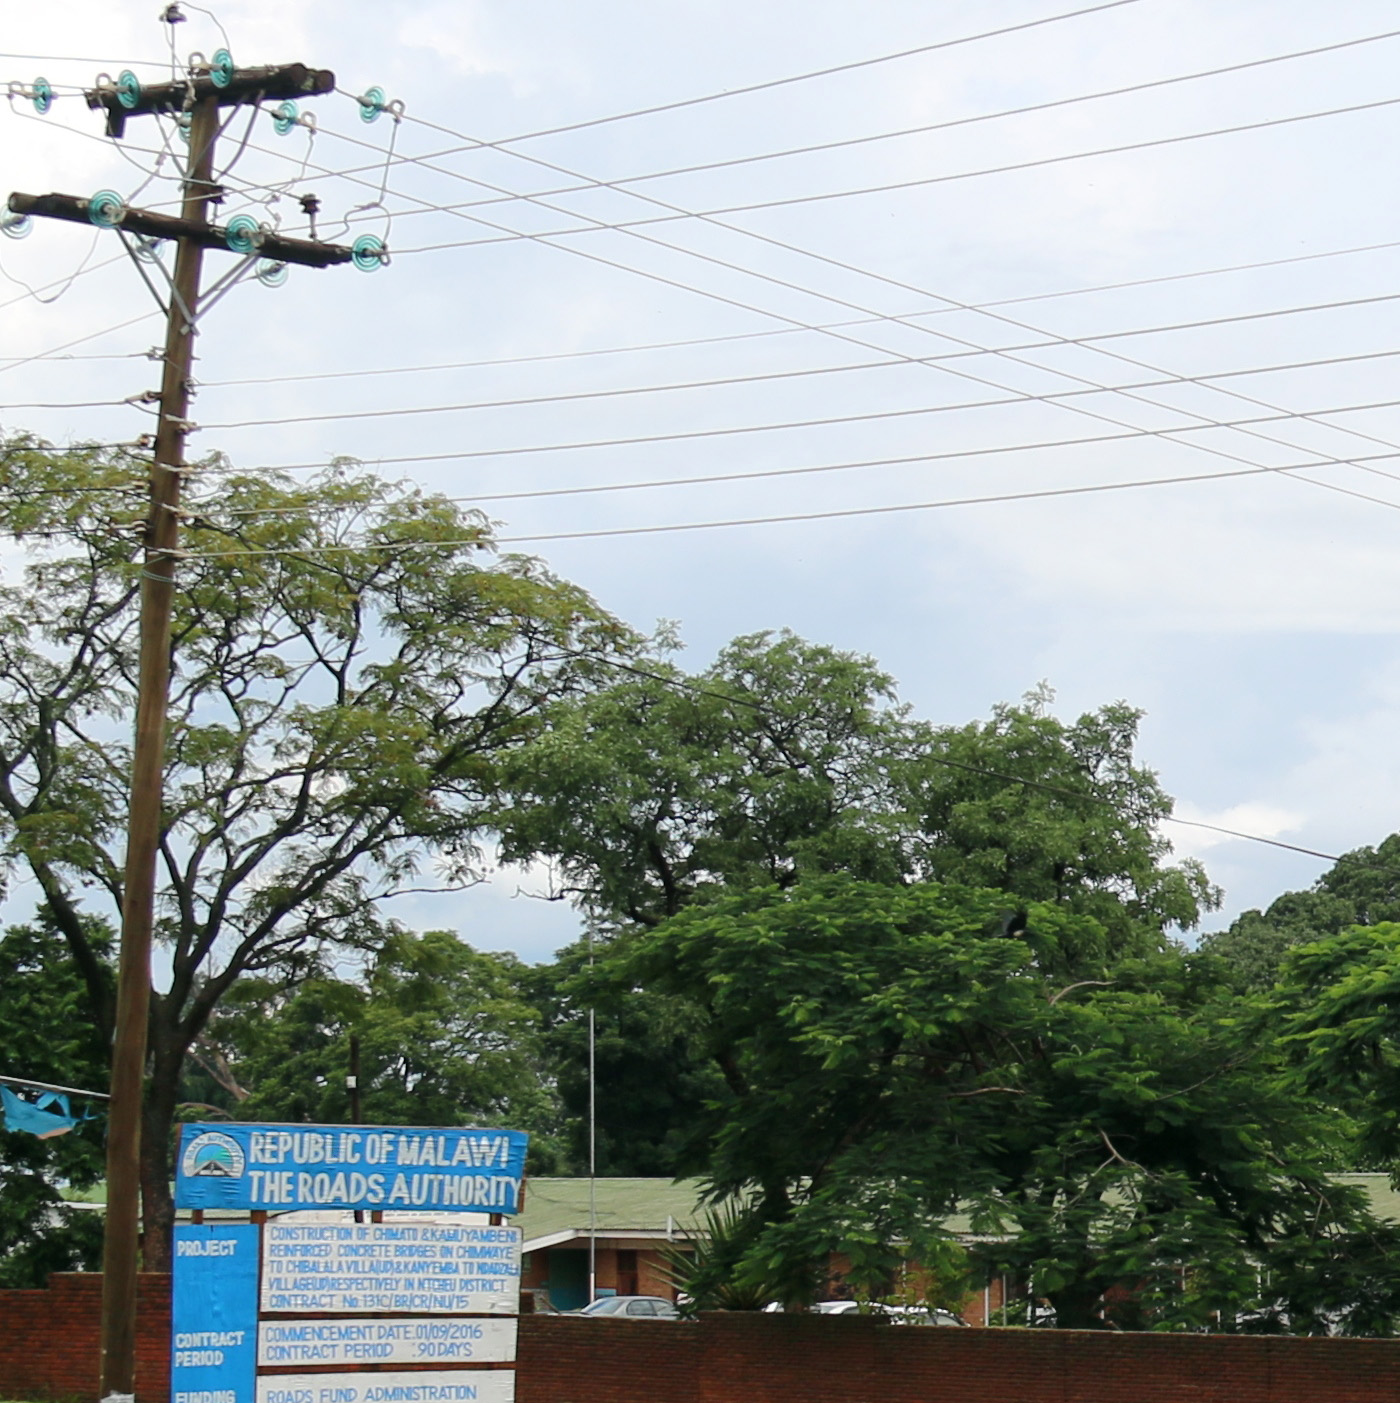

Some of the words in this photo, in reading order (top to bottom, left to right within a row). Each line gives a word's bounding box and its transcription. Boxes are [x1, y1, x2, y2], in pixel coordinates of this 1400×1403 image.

[250, 1131, 360, 1164] REPUBLIC
[366, 1133, 395, 1164] OF
[397, 1135, 509, 1168] MALAWI
[249, 1171, 293, 1203] THE
[298, 1172, 385, 1204] ROADS
[388, 1173, 522, 1208] AUTHORITY
[271, 1226, 352, 1241] CONSTRUCTION
[357, 1227, 370, 1240] OF
[177, 1239, 237, 1257] PROJECT
[269, 1243, 332, 1257] REINFORCED
[338, 1244, 392, 1258] CONCRETE
[394, 1244, 437, 1259] BRIDGES
[269, 1260, 283, 1273] TO
[462, 1262, 475, 1275] TO
[404, 1278, 415, 1291] IN
[269, 1293, 337, 1309] CONTRACT
[175, 1331, 245, 1348] CONTRACT
[265, 1325, 375, 1343] COMMENCEMENT
[175, 1350, 224, 1367] PERIOD
[266, 1344, 338, 1360] CONTRACT
[344, 1343, 394, 1358] PERIOD
[320, 1387, 358, 1403] FUND
[364, 1385, 477, 1402] ADMINISTRATION
